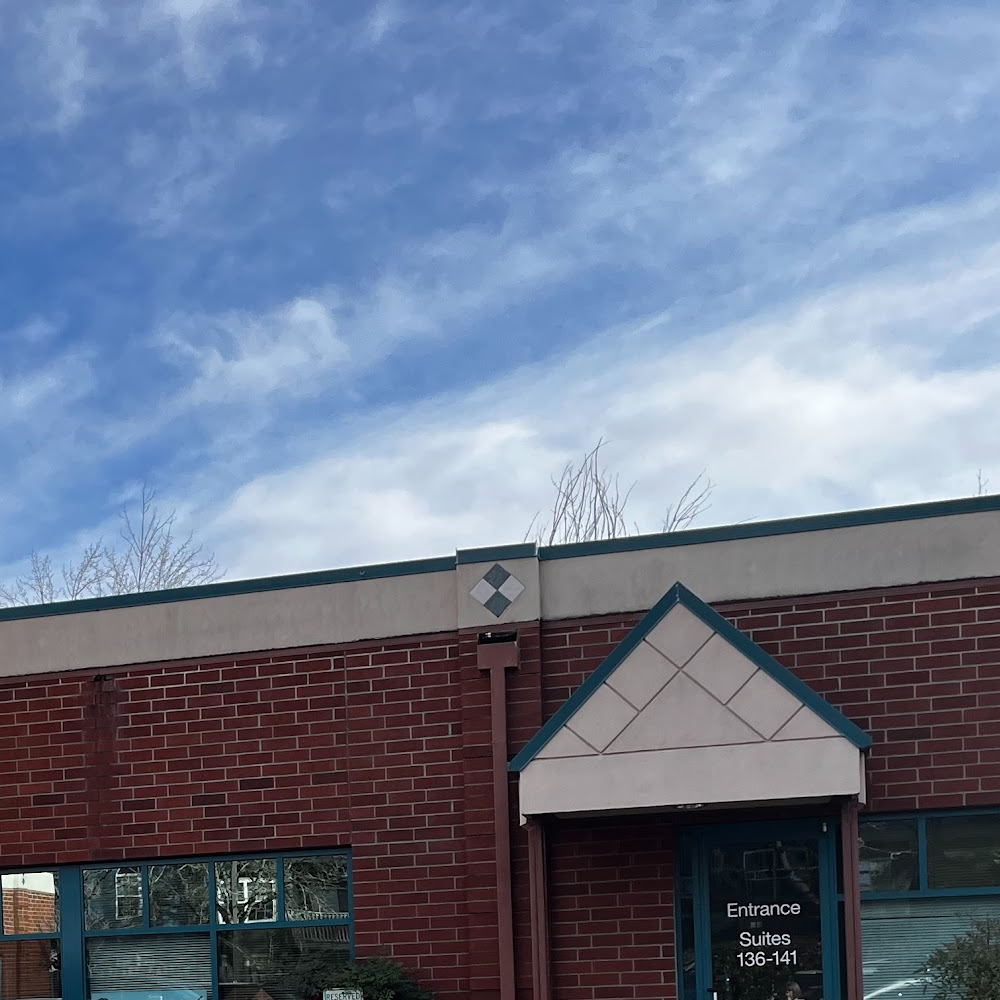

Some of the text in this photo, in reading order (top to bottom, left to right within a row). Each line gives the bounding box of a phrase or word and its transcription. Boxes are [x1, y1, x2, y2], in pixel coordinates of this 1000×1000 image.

[727, 903, 801, 917] Entrance
[739, 931, 791, 947] Suites
[736, 950, 797, 967] 136-141
[326, 992, 361, 1000] RESERVED
